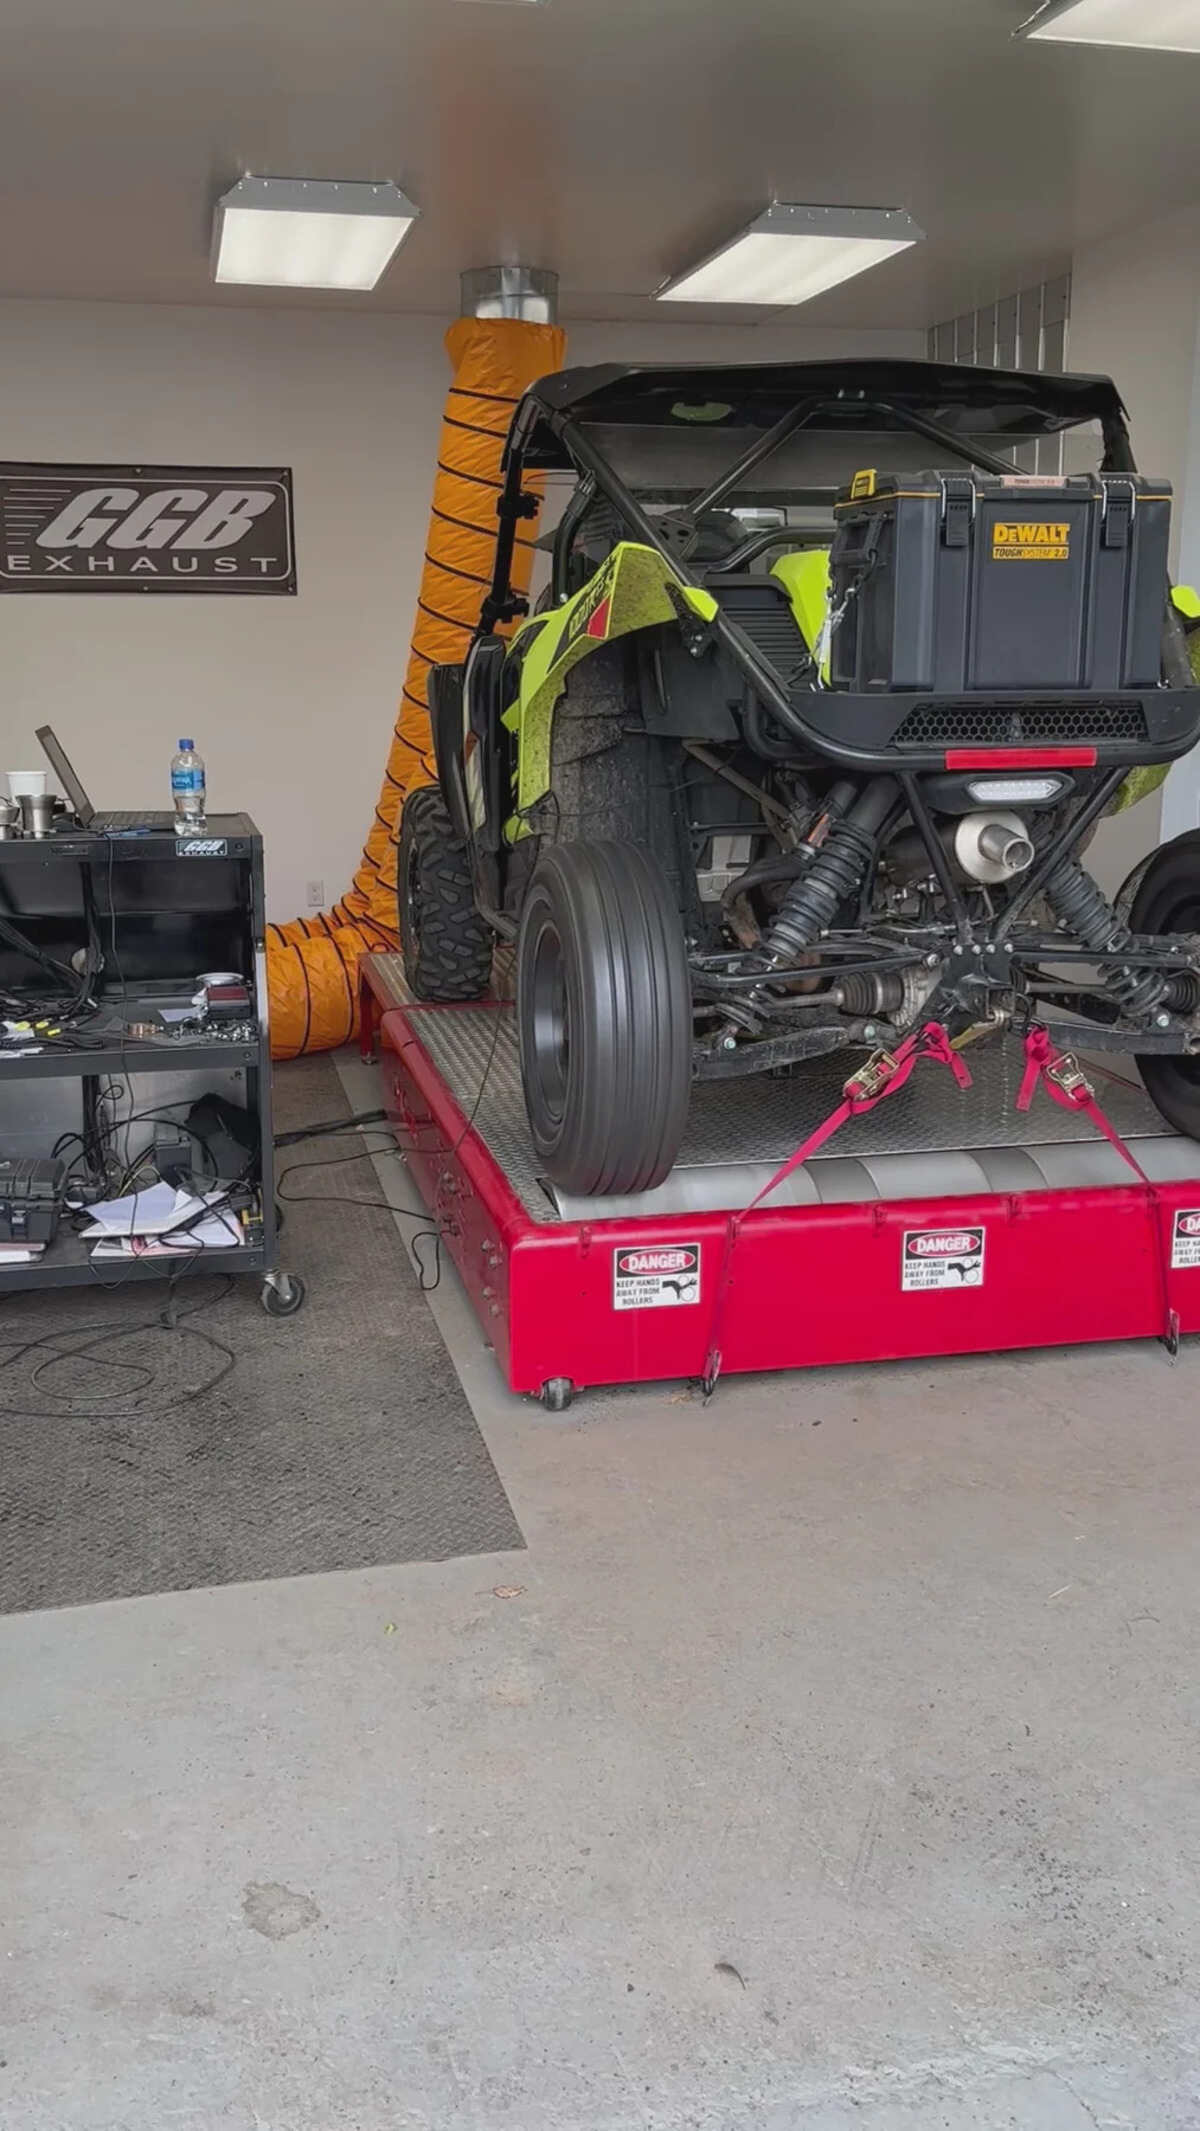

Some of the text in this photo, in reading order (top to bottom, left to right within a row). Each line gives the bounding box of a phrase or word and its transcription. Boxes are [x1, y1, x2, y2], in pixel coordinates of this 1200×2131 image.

[36, 488, 276, 550] GGB
[7, 555, 277, 573] EXHAUST
[917, 1237, 970, 1253] DANGER
[628, 1252, 686, 1270] DANGER
[616, 1277, 660, 1289] KEEP HANDS
[639, 1286, 660, 1296] FROM
[622, 1296, 654, 1306] ROLLERS
